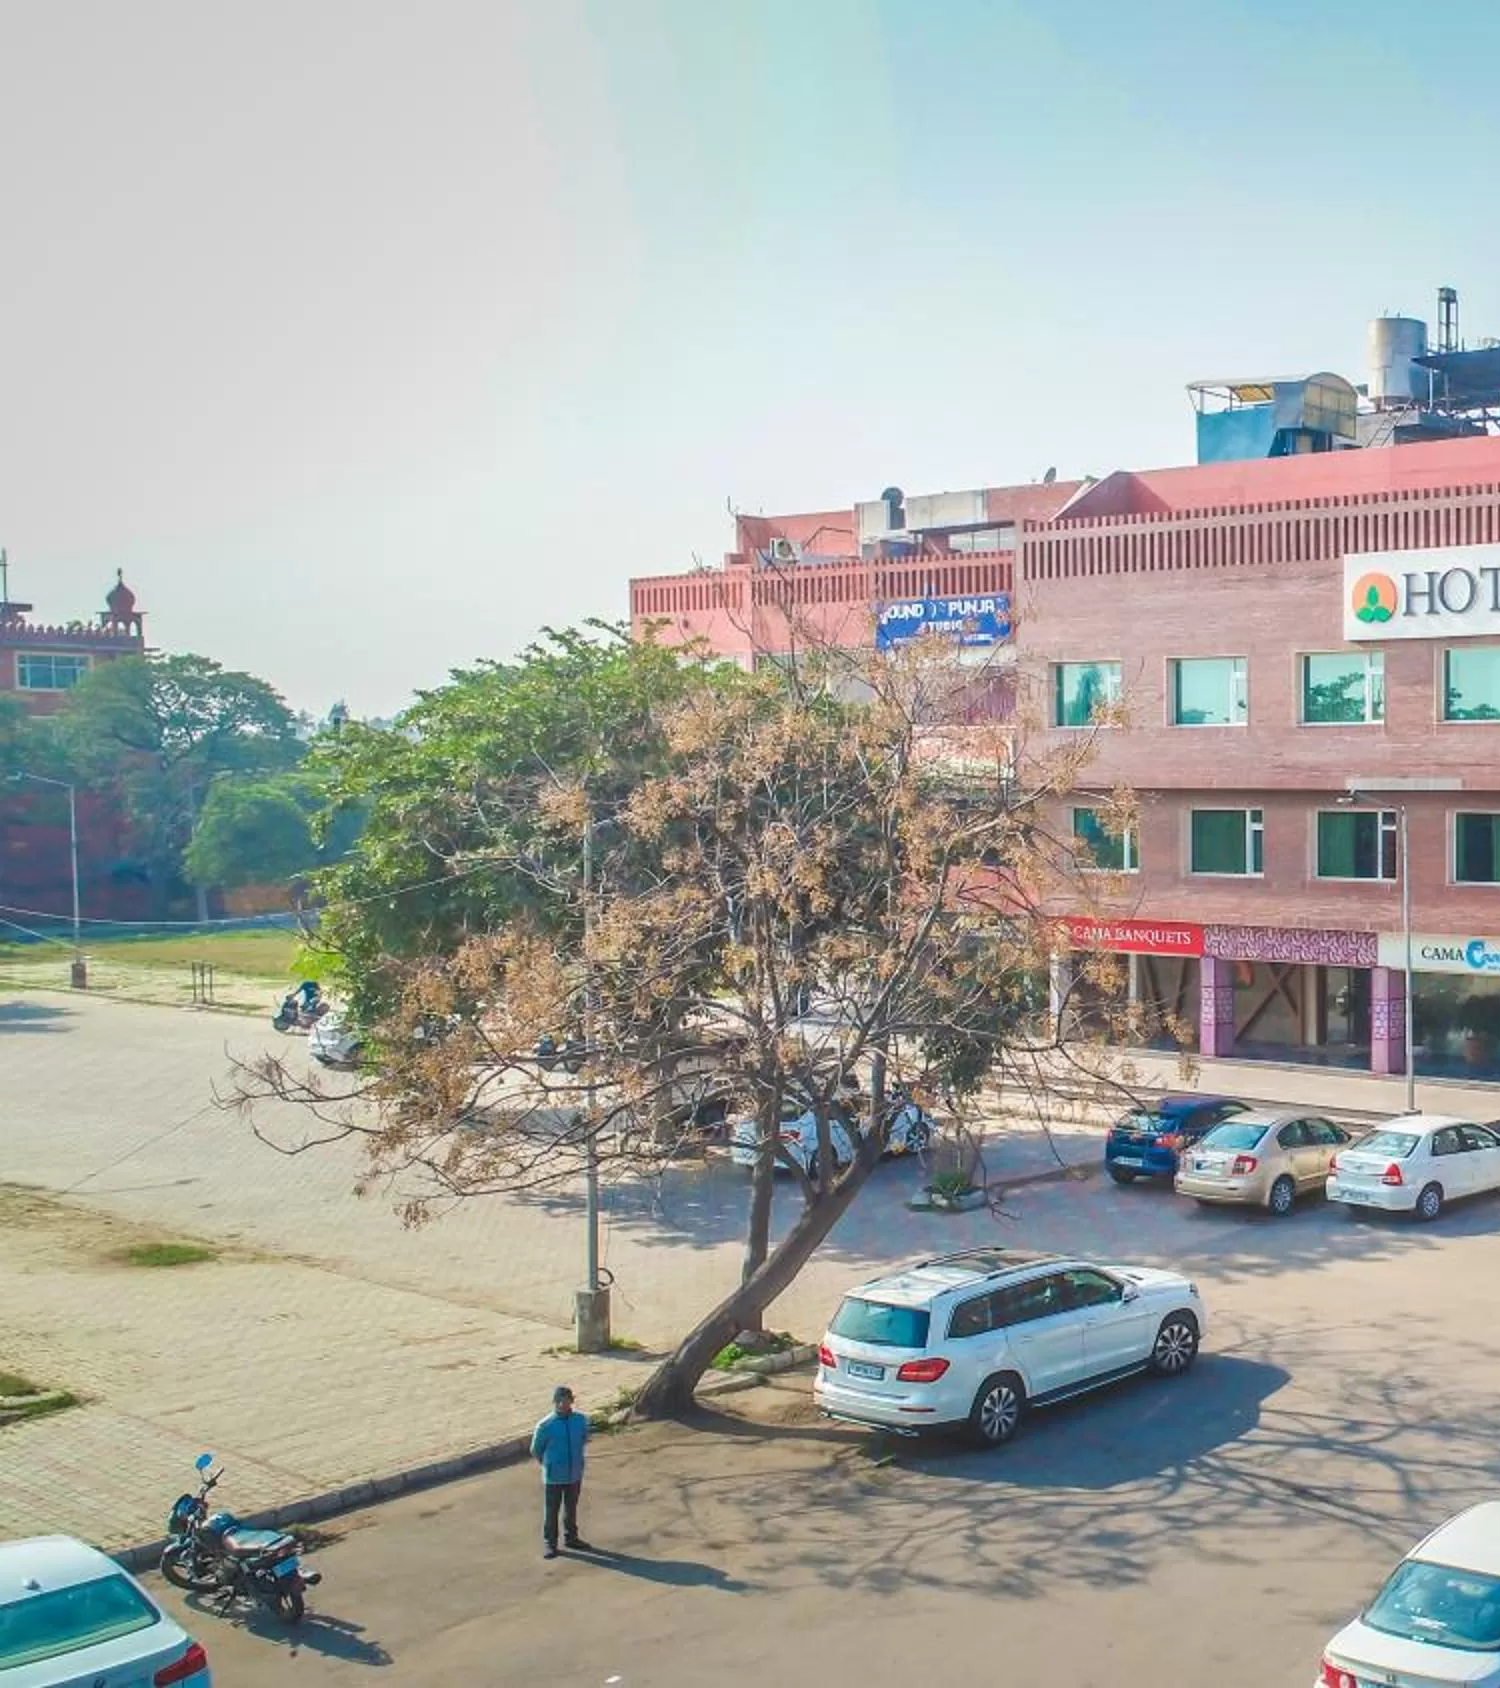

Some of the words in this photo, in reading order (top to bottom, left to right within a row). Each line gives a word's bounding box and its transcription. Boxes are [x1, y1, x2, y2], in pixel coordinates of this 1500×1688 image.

[1073, 925, 1111, 940] CAMA
[1114, 927, 1191, 946] BANQUETS
[1421, 946, 1465, 962] CAMA
